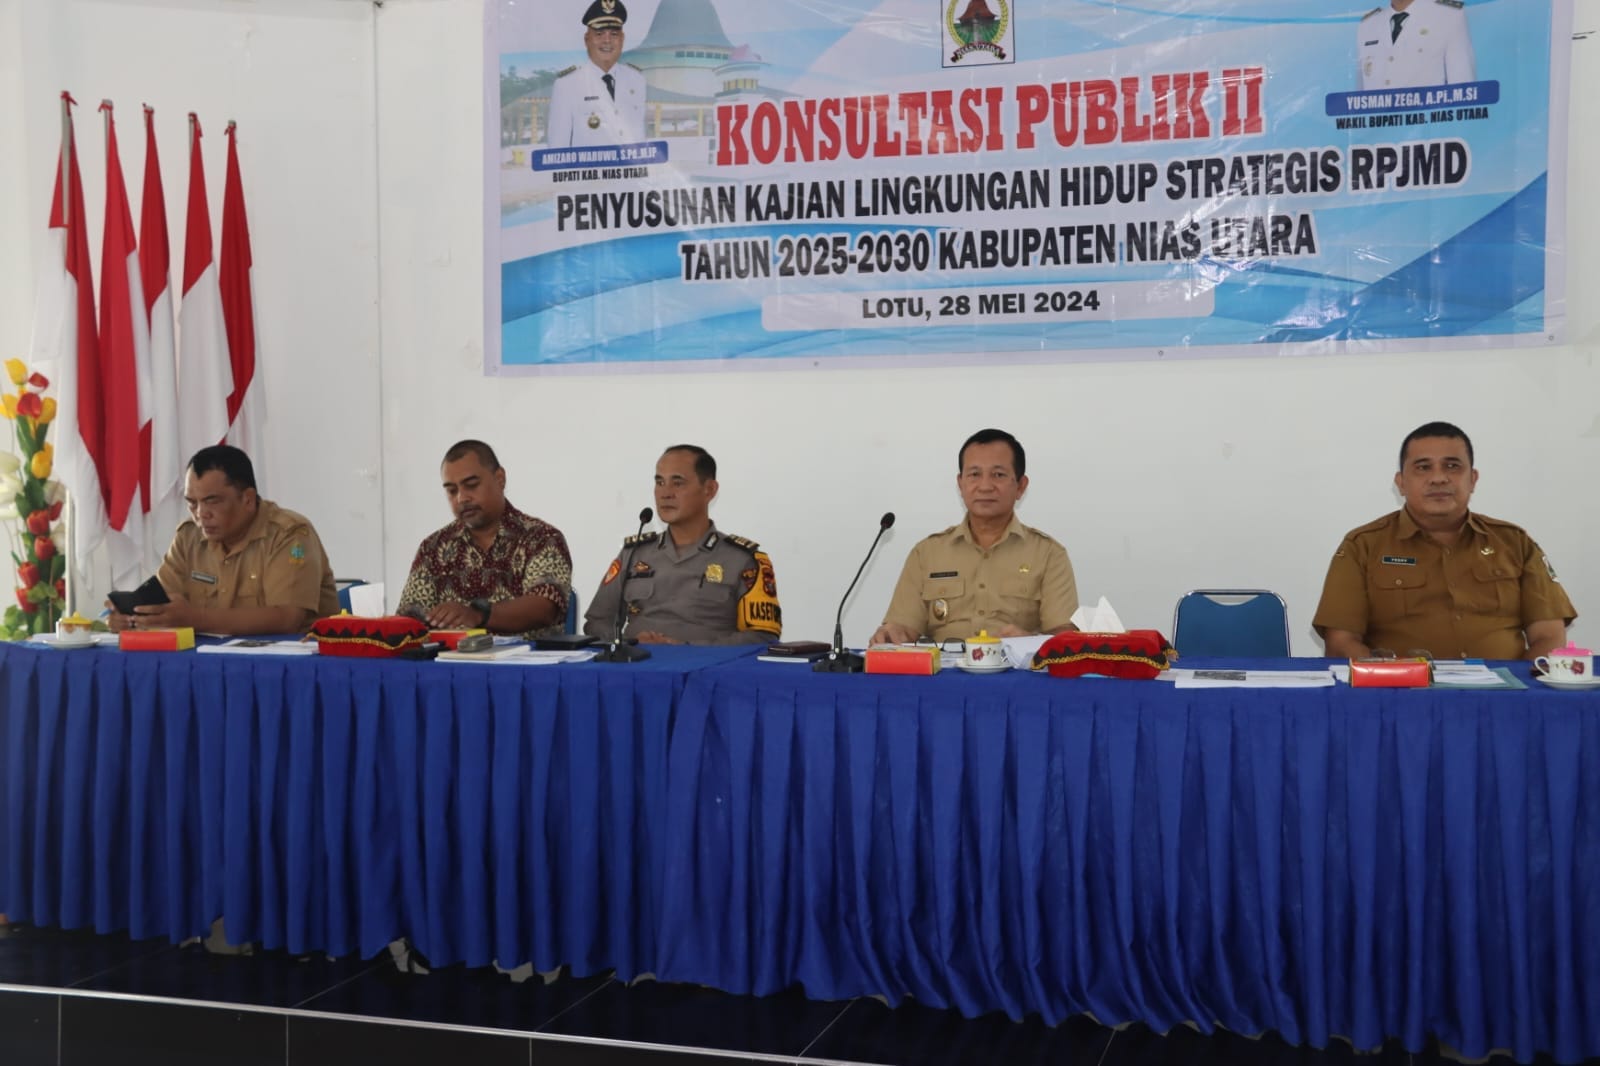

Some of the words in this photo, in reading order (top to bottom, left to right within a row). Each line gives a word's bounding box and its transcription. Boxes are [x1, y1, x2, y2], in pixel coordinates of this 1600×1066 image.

[1346, 94, 1392, 110] YUSMAN
[1394, 92, 1424, 107] ZEGA,
[717, 87, 1003, 166] KONSULTASI
[1016, 71, 1209, 149] PUBLIK
[1222, 67, 1263, 136] II
[1336, 117, 1367, 130] WAKIL
[1369, 114, 1403, 128] BUPATI
[1405, 113, 1428, 126] KAB.
[1430, 110, 1454, 123] NIAS
[1456, 107, 1489, 121] UTARA
[542, 152, 577, 165] AMIZARO
[552, 170, 580, 183] BUPATI
[582, 169, 600, 181] KAB.
[602, 168, 622, 180] NIAS
[624, 167, 648, 179] UTARA
[557, 185, 736, 232] PENYUSUNAN
[745, 180, 845, 222] KAJIAN
[855, 168, 1050, 217] LINGKUNGAN
[1060, 163, 1158, 207] HIDUP
[1165, 150, 1341, 200] STRATEGIS
[1351, 142, 1467, 190] RPJMD
[681, 240, 770, 280] TAHUN
[778, 232, 930, 276] 2025-2030
[939, 223, 1115, 270] KABUPATEN
[1126, 219, 1202, 261] NIAS
[1211, 213, 1316, 257] UTARA
[862, 297, 931, 320] LOTU,
[939, 295, 971, 316] 28
[978, 293, 1025, 314] MEI
[1034, 290, 1100, 312] 2024
